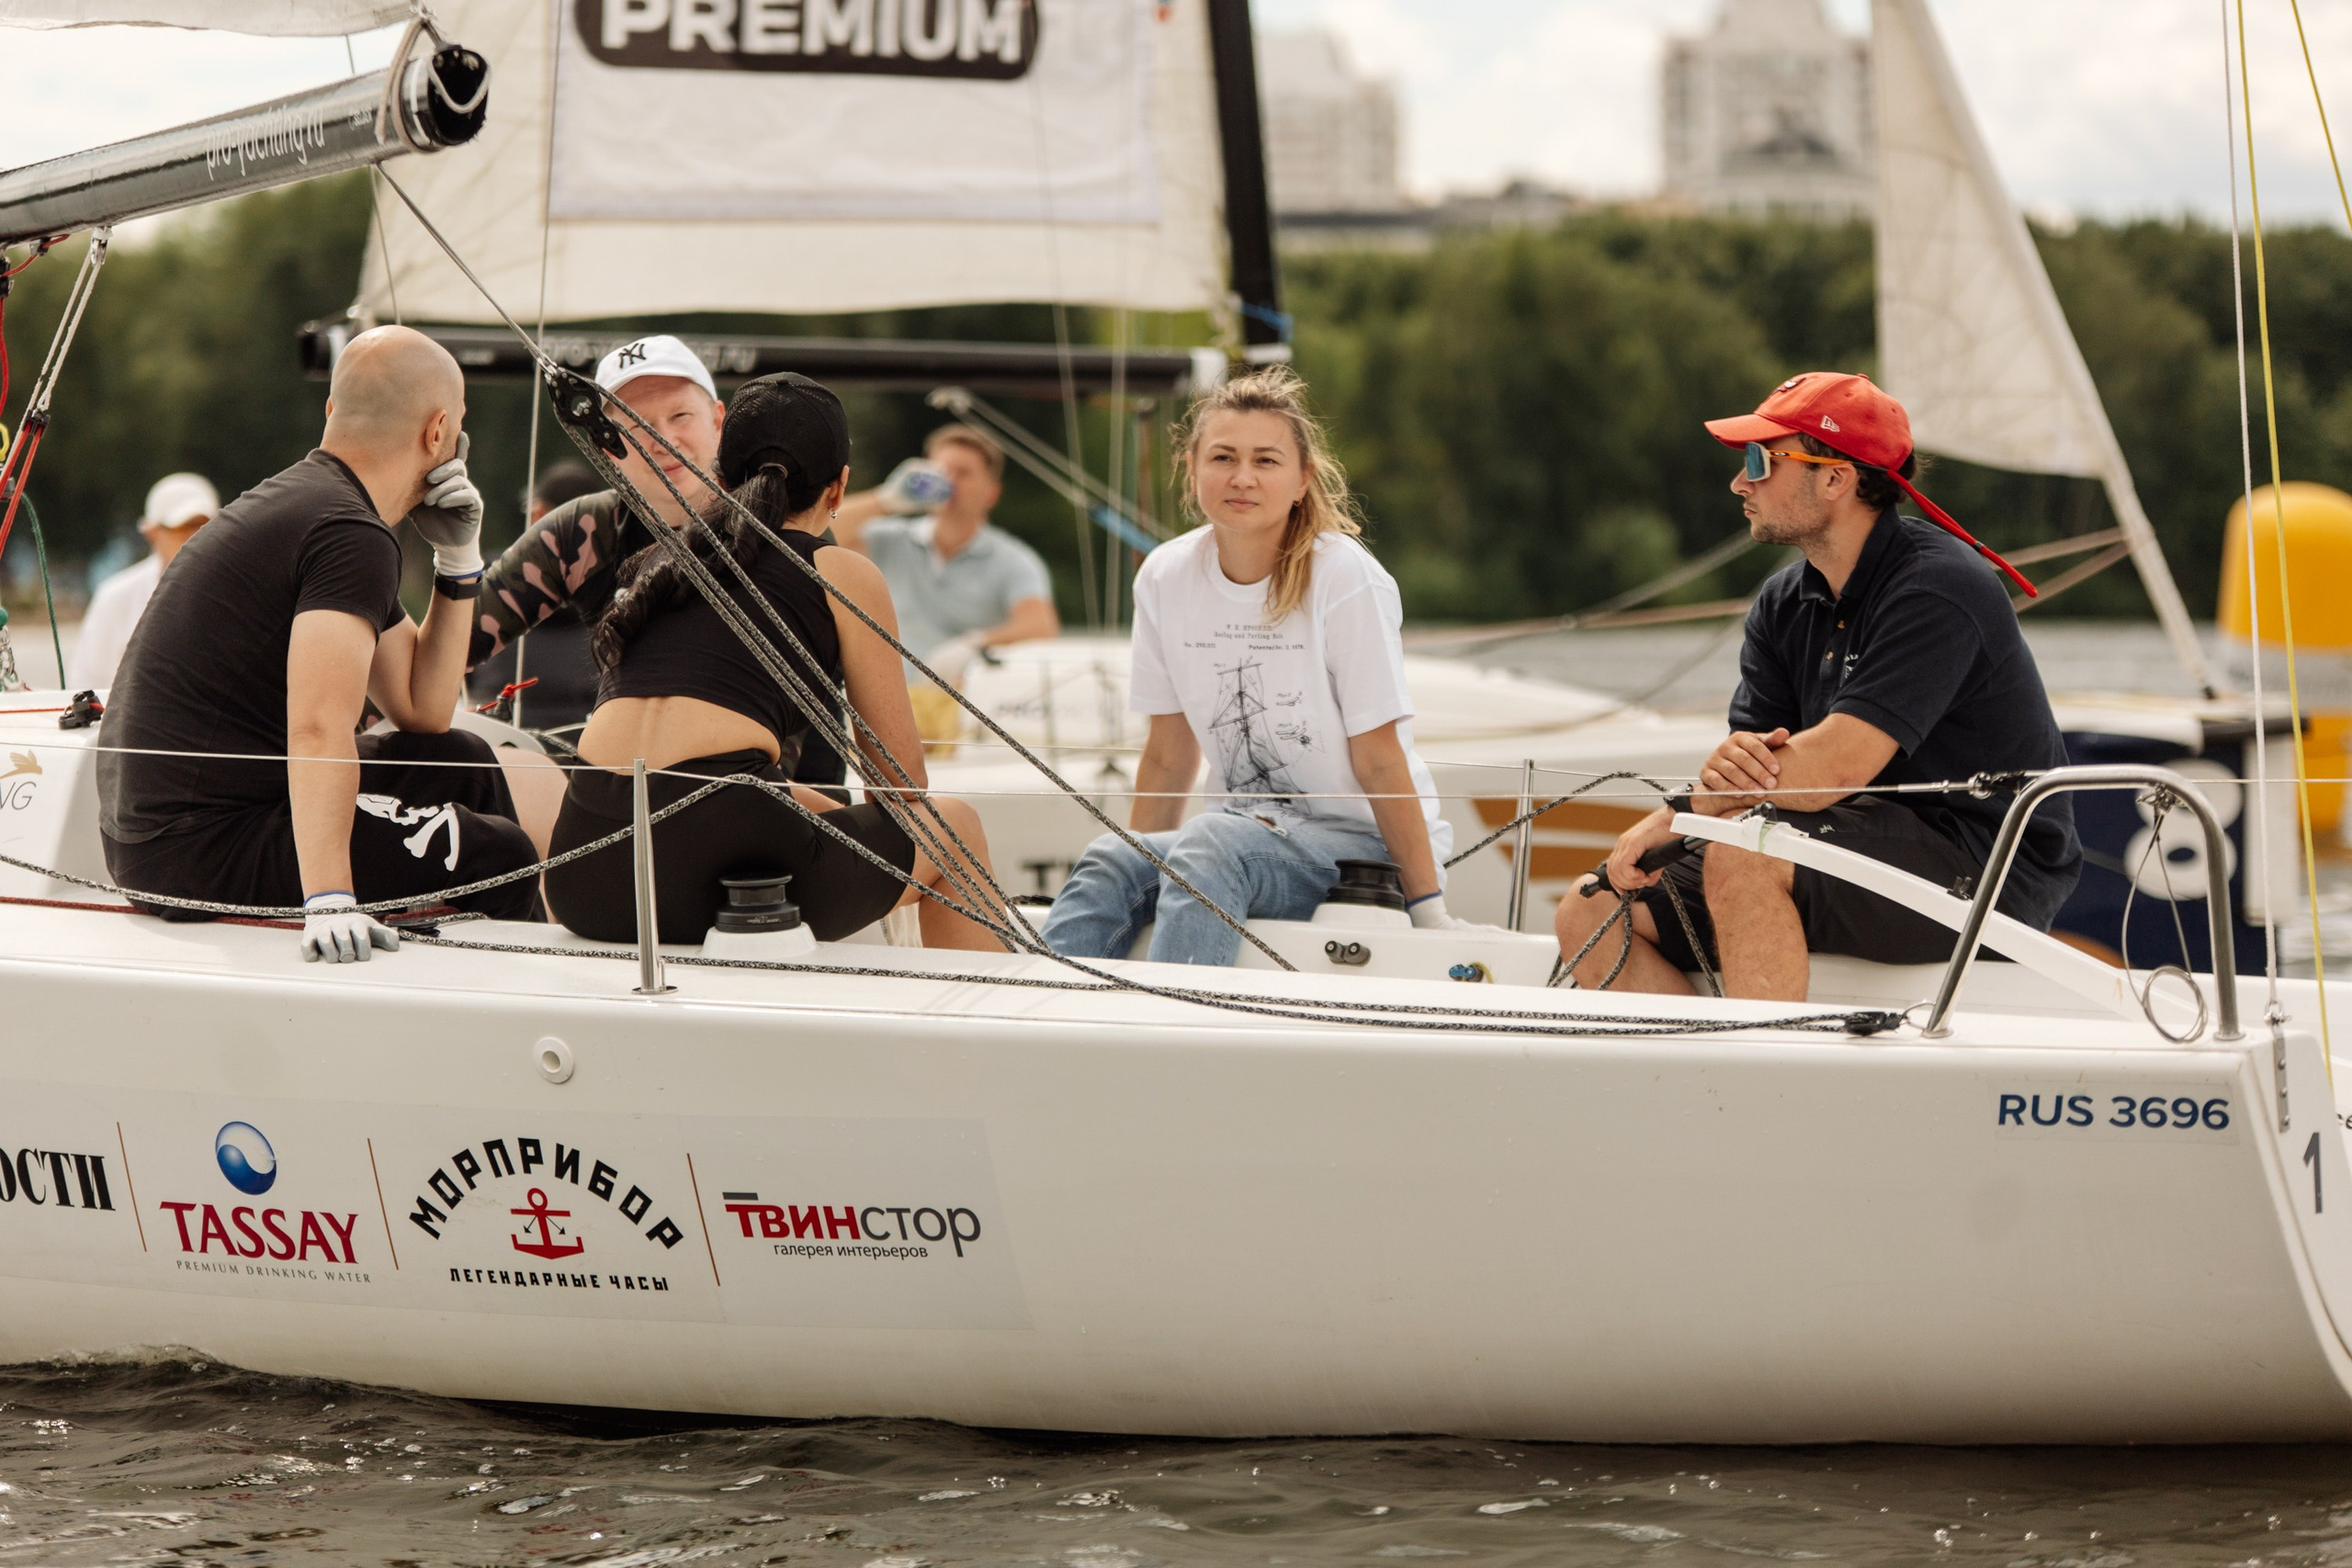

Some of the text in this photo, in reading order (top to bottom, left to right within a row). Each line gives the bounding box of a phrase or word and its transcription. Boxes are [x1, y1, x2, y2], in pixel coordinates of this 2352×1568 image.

[600, 0, 1023, 63] PREMIUM
[1998, 1094, 2230, 1130] RUS 3696
[409, 1137, 684, 1249] МОРПРИБОР
[2302, 1132, 2323, 1213] 1
[159, 1201, 359, 1264] TASSAY
[774, 1244, 929, 1261] галерея интерьеров
[175, 1259, 371, 1284] PREMIUM DRINKING WATER
[449, 1268, 669, 1292] ЛЕГЕНДАРНЫЕ ЧАСЫ
